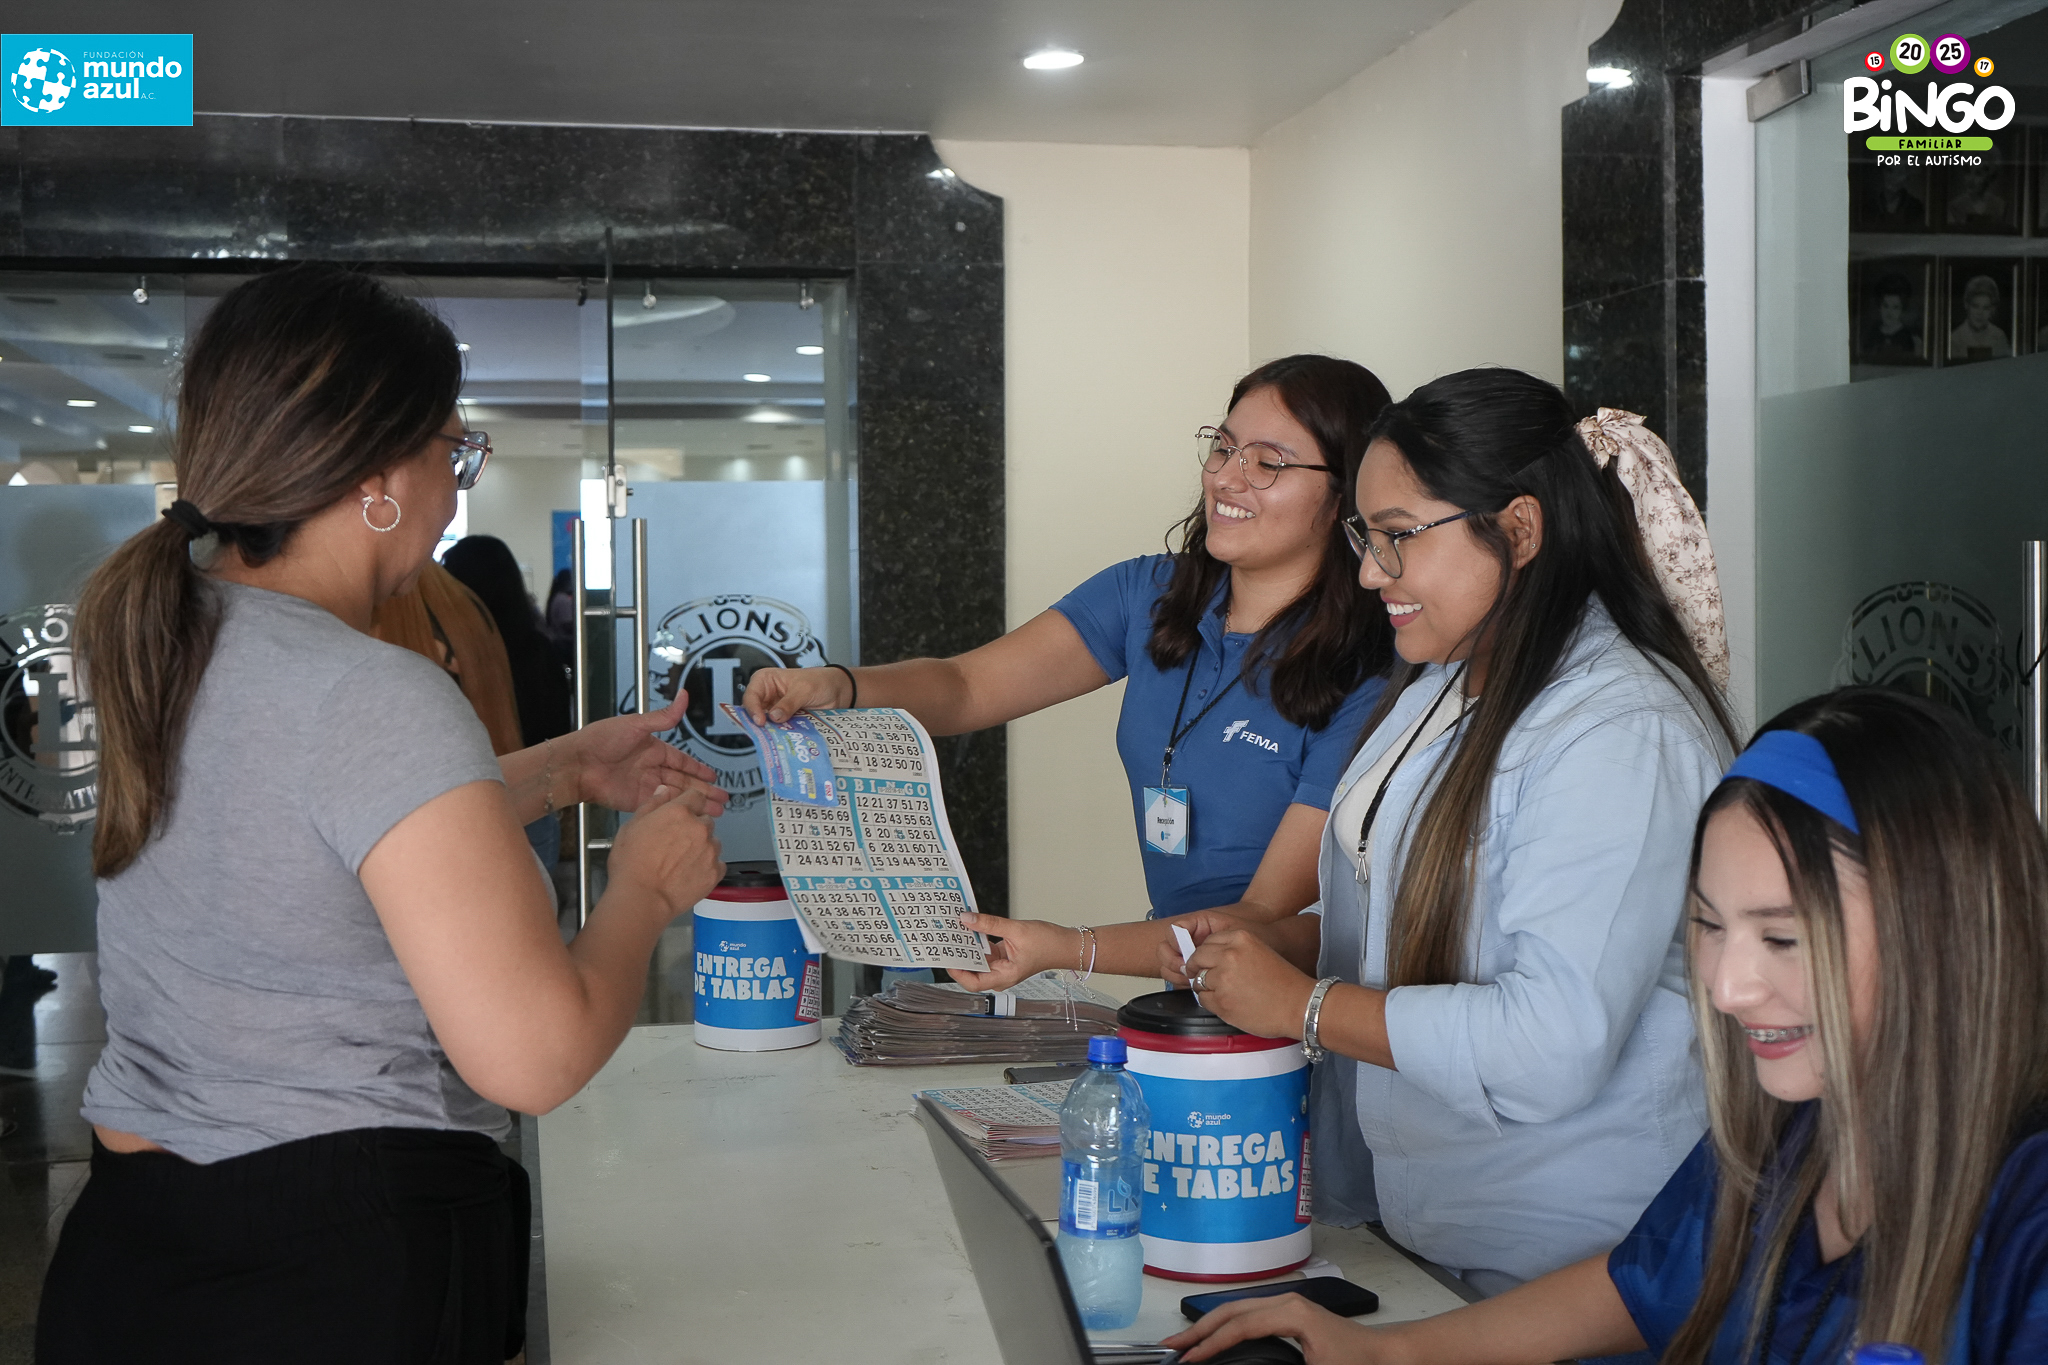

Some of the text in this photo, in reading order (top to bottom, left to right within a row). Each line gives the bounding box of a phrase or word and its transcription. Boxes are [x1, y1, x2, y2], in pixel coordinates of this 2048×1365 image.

[678, 608, 790, 644] LIONS
[1858, 606, 1984, 675] LIONS
[1239, 730, 1279, 754] FEMA
[856, 796, 869, 807] 12
[871, 797, 883, 808] 21
[886, 799, 898, 809] 37
[901, 799, 914, 810] 51
[916, 800, 929, 811] 73
[776, 807, 849, 821] 8 19 45 56 69
[861, 812, 932, 826] 2 25 43 55 63
[778, 823, 853, 837] 3 17 54 75
[864, 827, 936, 840] 8 20 52 61
[778, 839, 855, 852] 11 20 31 52 67
[868, 842, 941, 853] 6 28 31 60 71
[784, 854, 861, 866] 7 24 43 47 74
[870, 856, 948, 866] 15 19 44 58 72
[794, 893, 877, 903] 10 18 32 51 70
[889, 892, 962, 902] 1 19 33 52 69
[803, 907, 884, 916] 9 24 38 46 72
[891, 906, 906, 915] 10
[907, 906, 920, 915] 27
[924, 906, 936, 915] 37
[940, 906, 951, 915] 57
[824, 920, 839, 930] 16
[857, 920, 872, 930] 55
[874, 920, 889, 930] 69
[897, 920, 912, 929] 13
[914, 920, 928, 929] 25
[945, 920, 958, 929] 56
[847, 933, 860, 943] 37
[863, 934, 878, 943] 50
[880, 933, 895, 943] 66
[904, 933, 976, 946] 14 30 35 49 72
[870, 947, 886, 956] 52
[886, 947, 901, 956] 71
[912, 947, 981, 960] 5 22 45 55 73
[696, 952, 787, 978] ENTREGA
[711, 977, 795, 1000] TABLAS
[1205, 1112, 1231, 1120] mundo
[1205, 1118, 1221, 1126] azul
[1172, 1160, 1295, 1200] TABLAS
